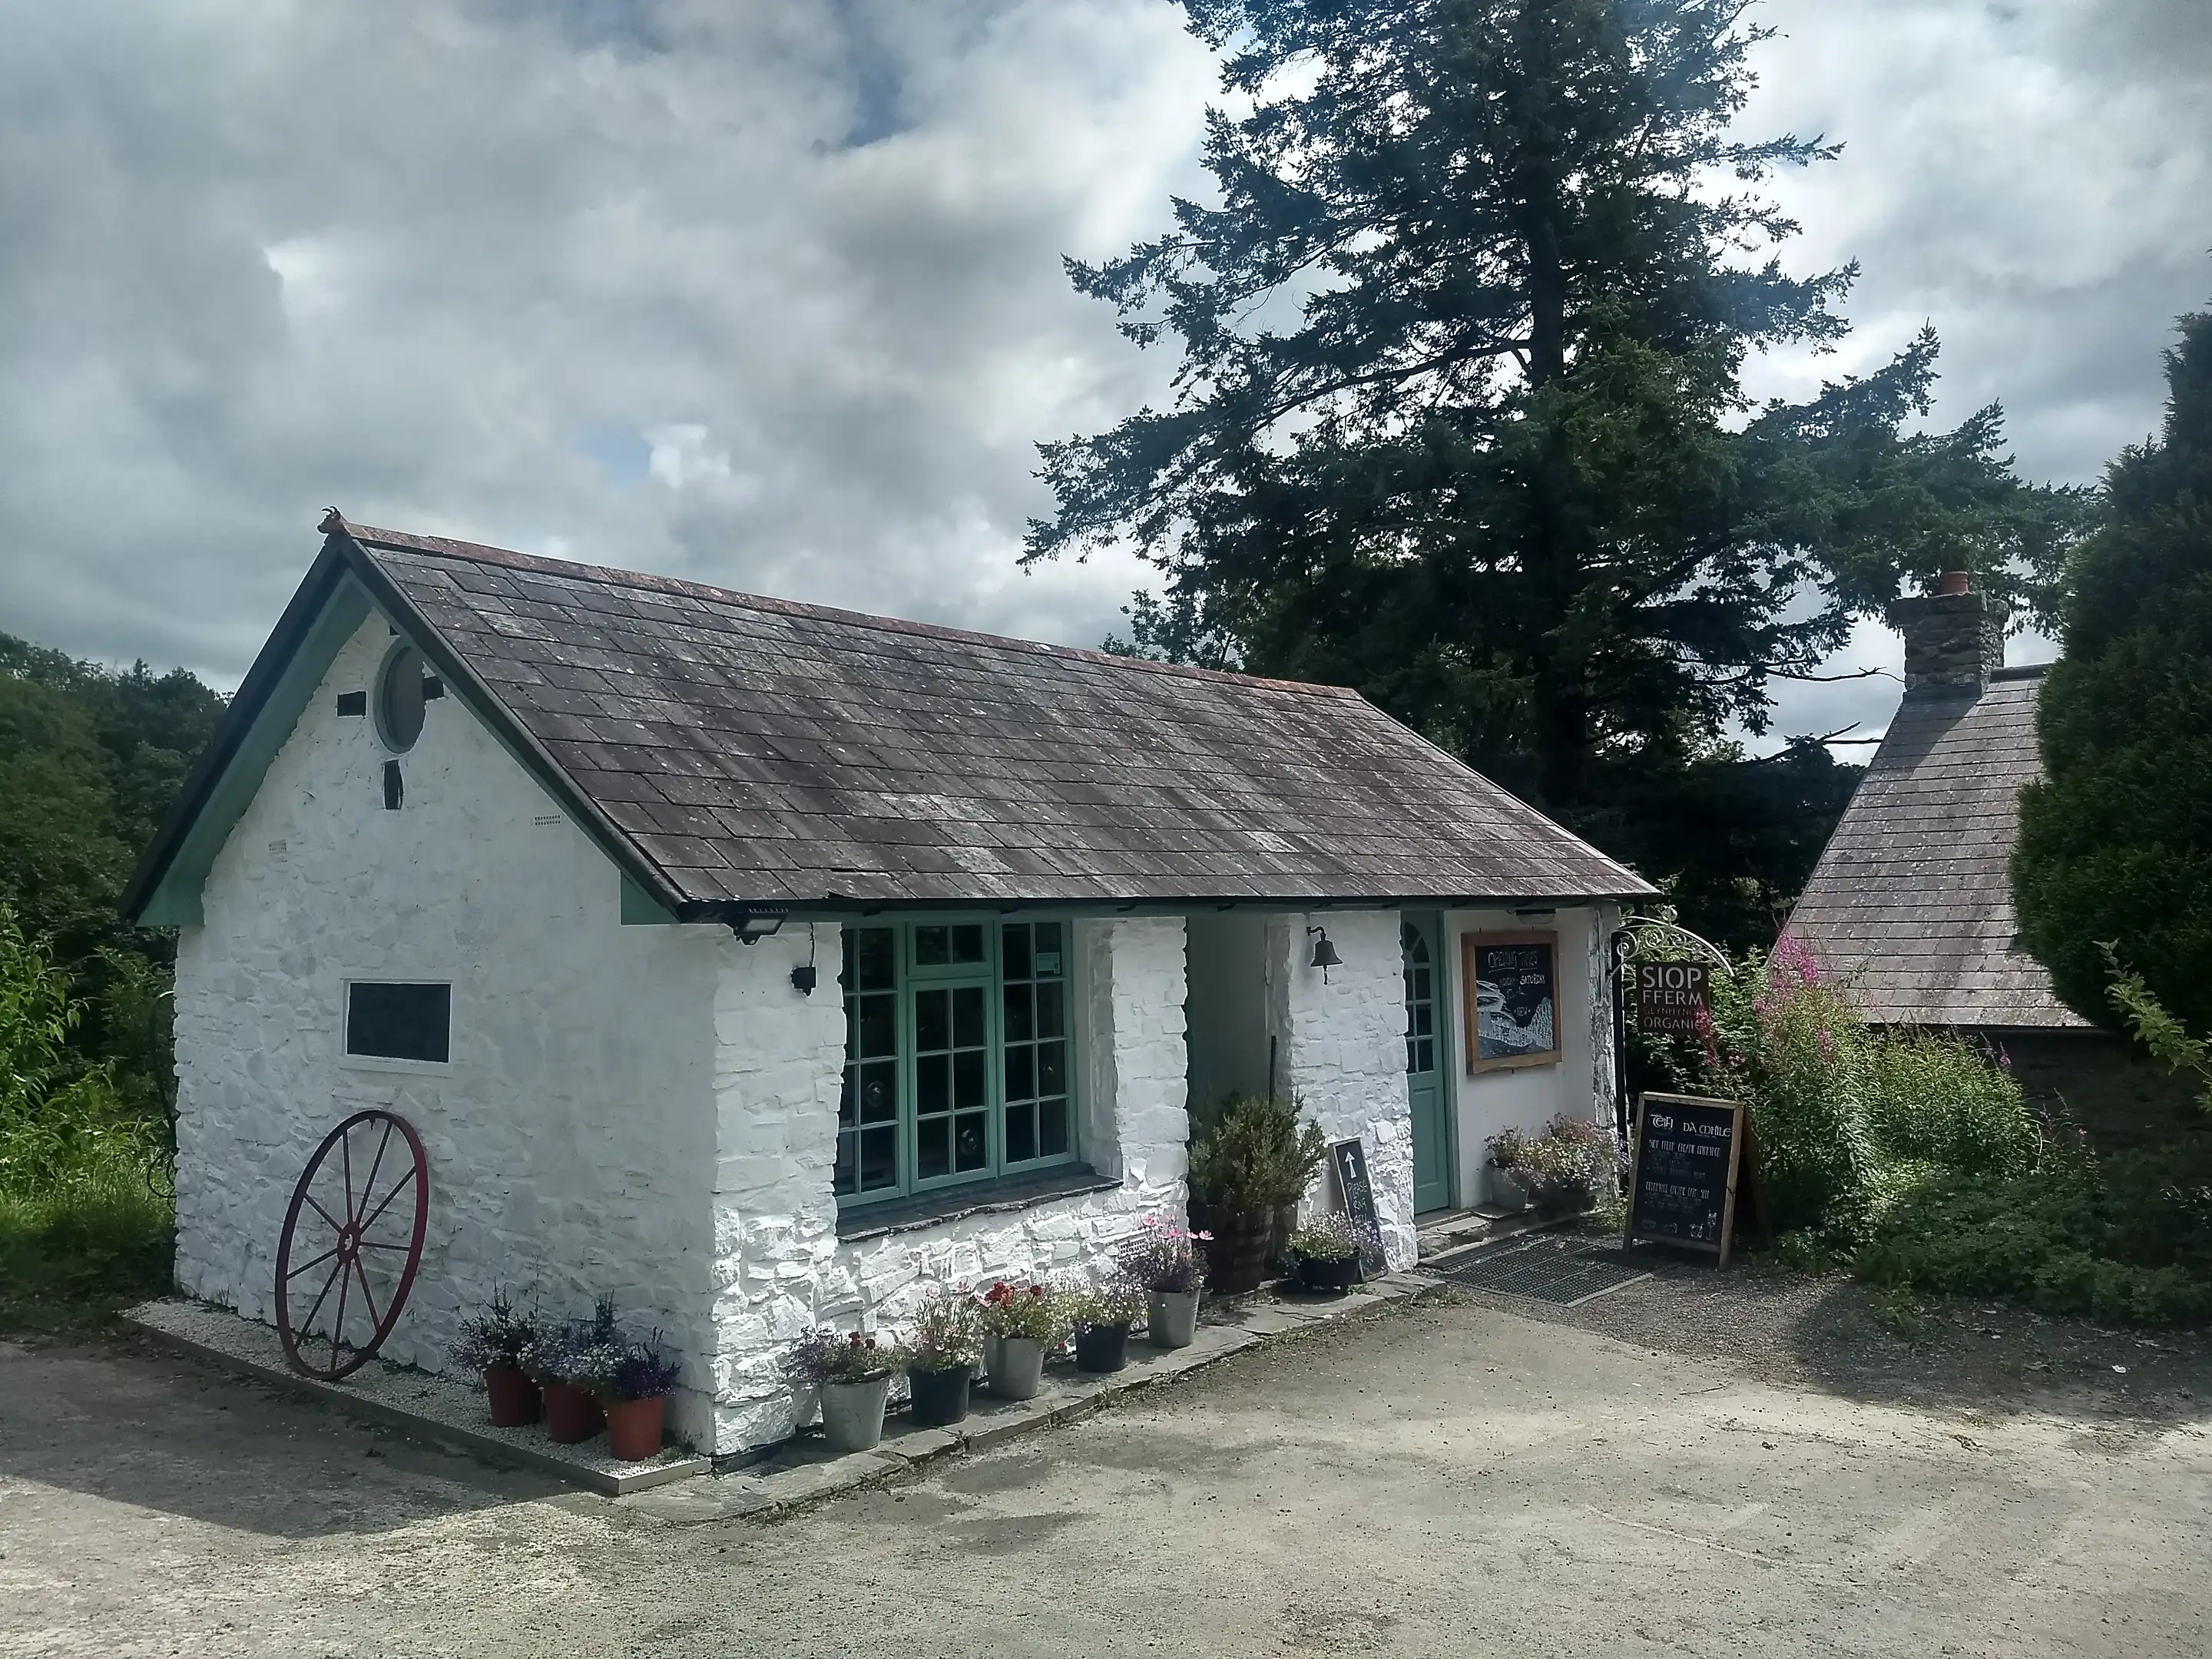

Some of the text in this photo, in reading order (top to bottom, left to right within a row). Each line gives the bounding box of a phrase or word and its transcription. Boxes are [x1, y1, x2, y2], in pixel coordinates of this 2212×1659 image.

[1488, 951, 1538, 968] OPENING TIMES
[1520, 973, 1545, 985] SATURDAY
[1642, 966, 1702, 989] SIOP
[1643, 989, 1703, 1005] FFERM
[1346, 1180, 1367, 1201] PLEASE
